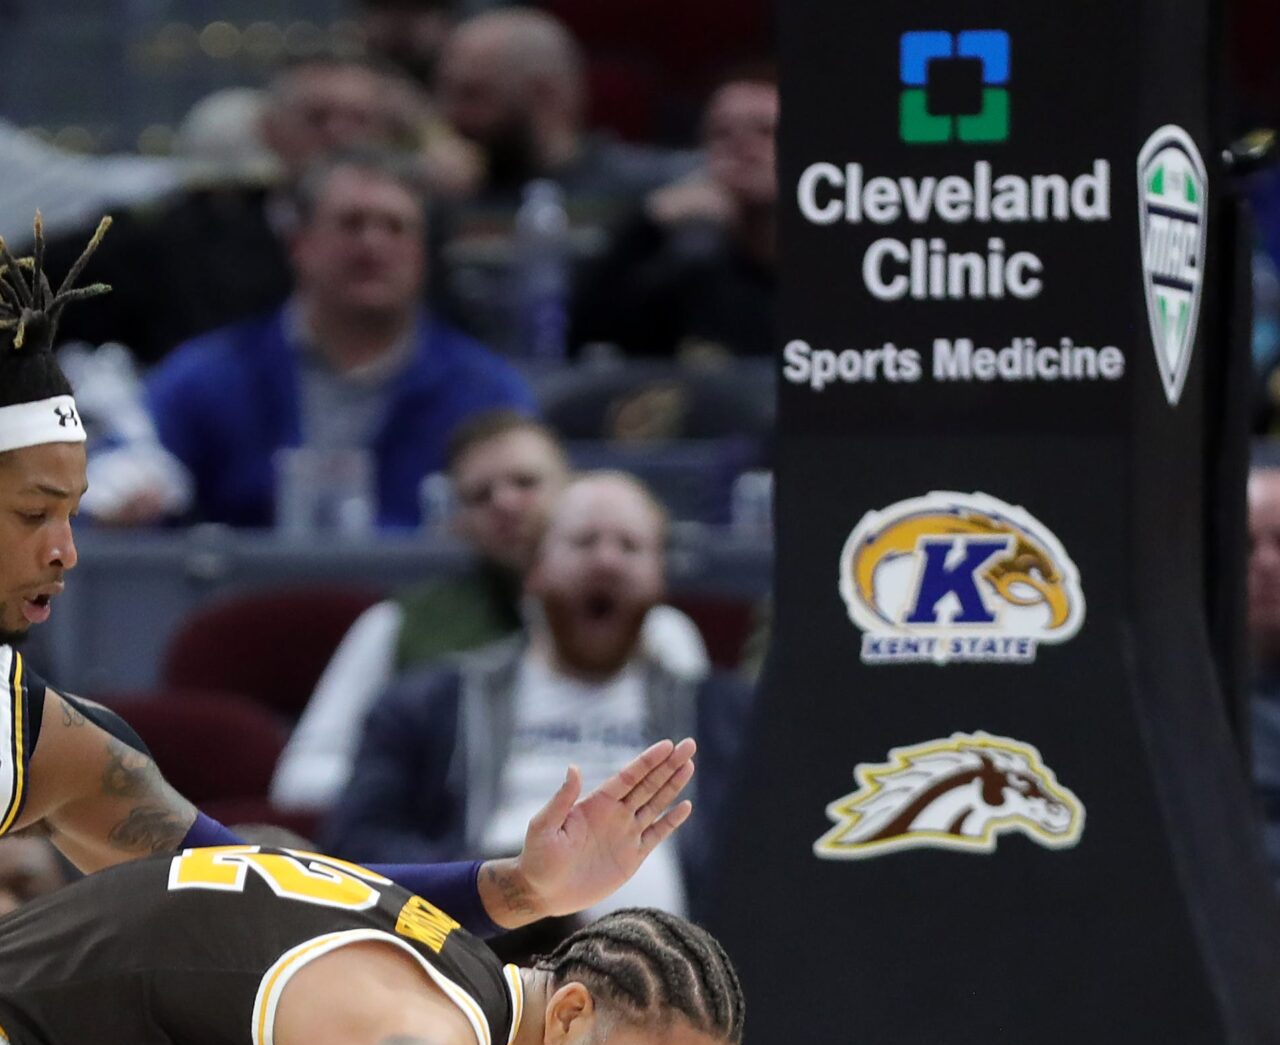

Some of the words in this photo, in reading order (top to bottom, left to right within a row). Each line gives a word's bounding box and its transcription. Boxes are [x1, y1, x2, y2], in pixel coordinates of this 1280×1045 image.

[797, 158, 1111, 225] Cleveland
[862, 237, 1044, 301] Clinic
[783, 338, 922, 391] Sports
[932, 336, 1125, 381] Medicine
[903, 541, 1010, 623] K
[869, 636, 938, 655] KENT
[949, 636, 1031, 655] STATE
